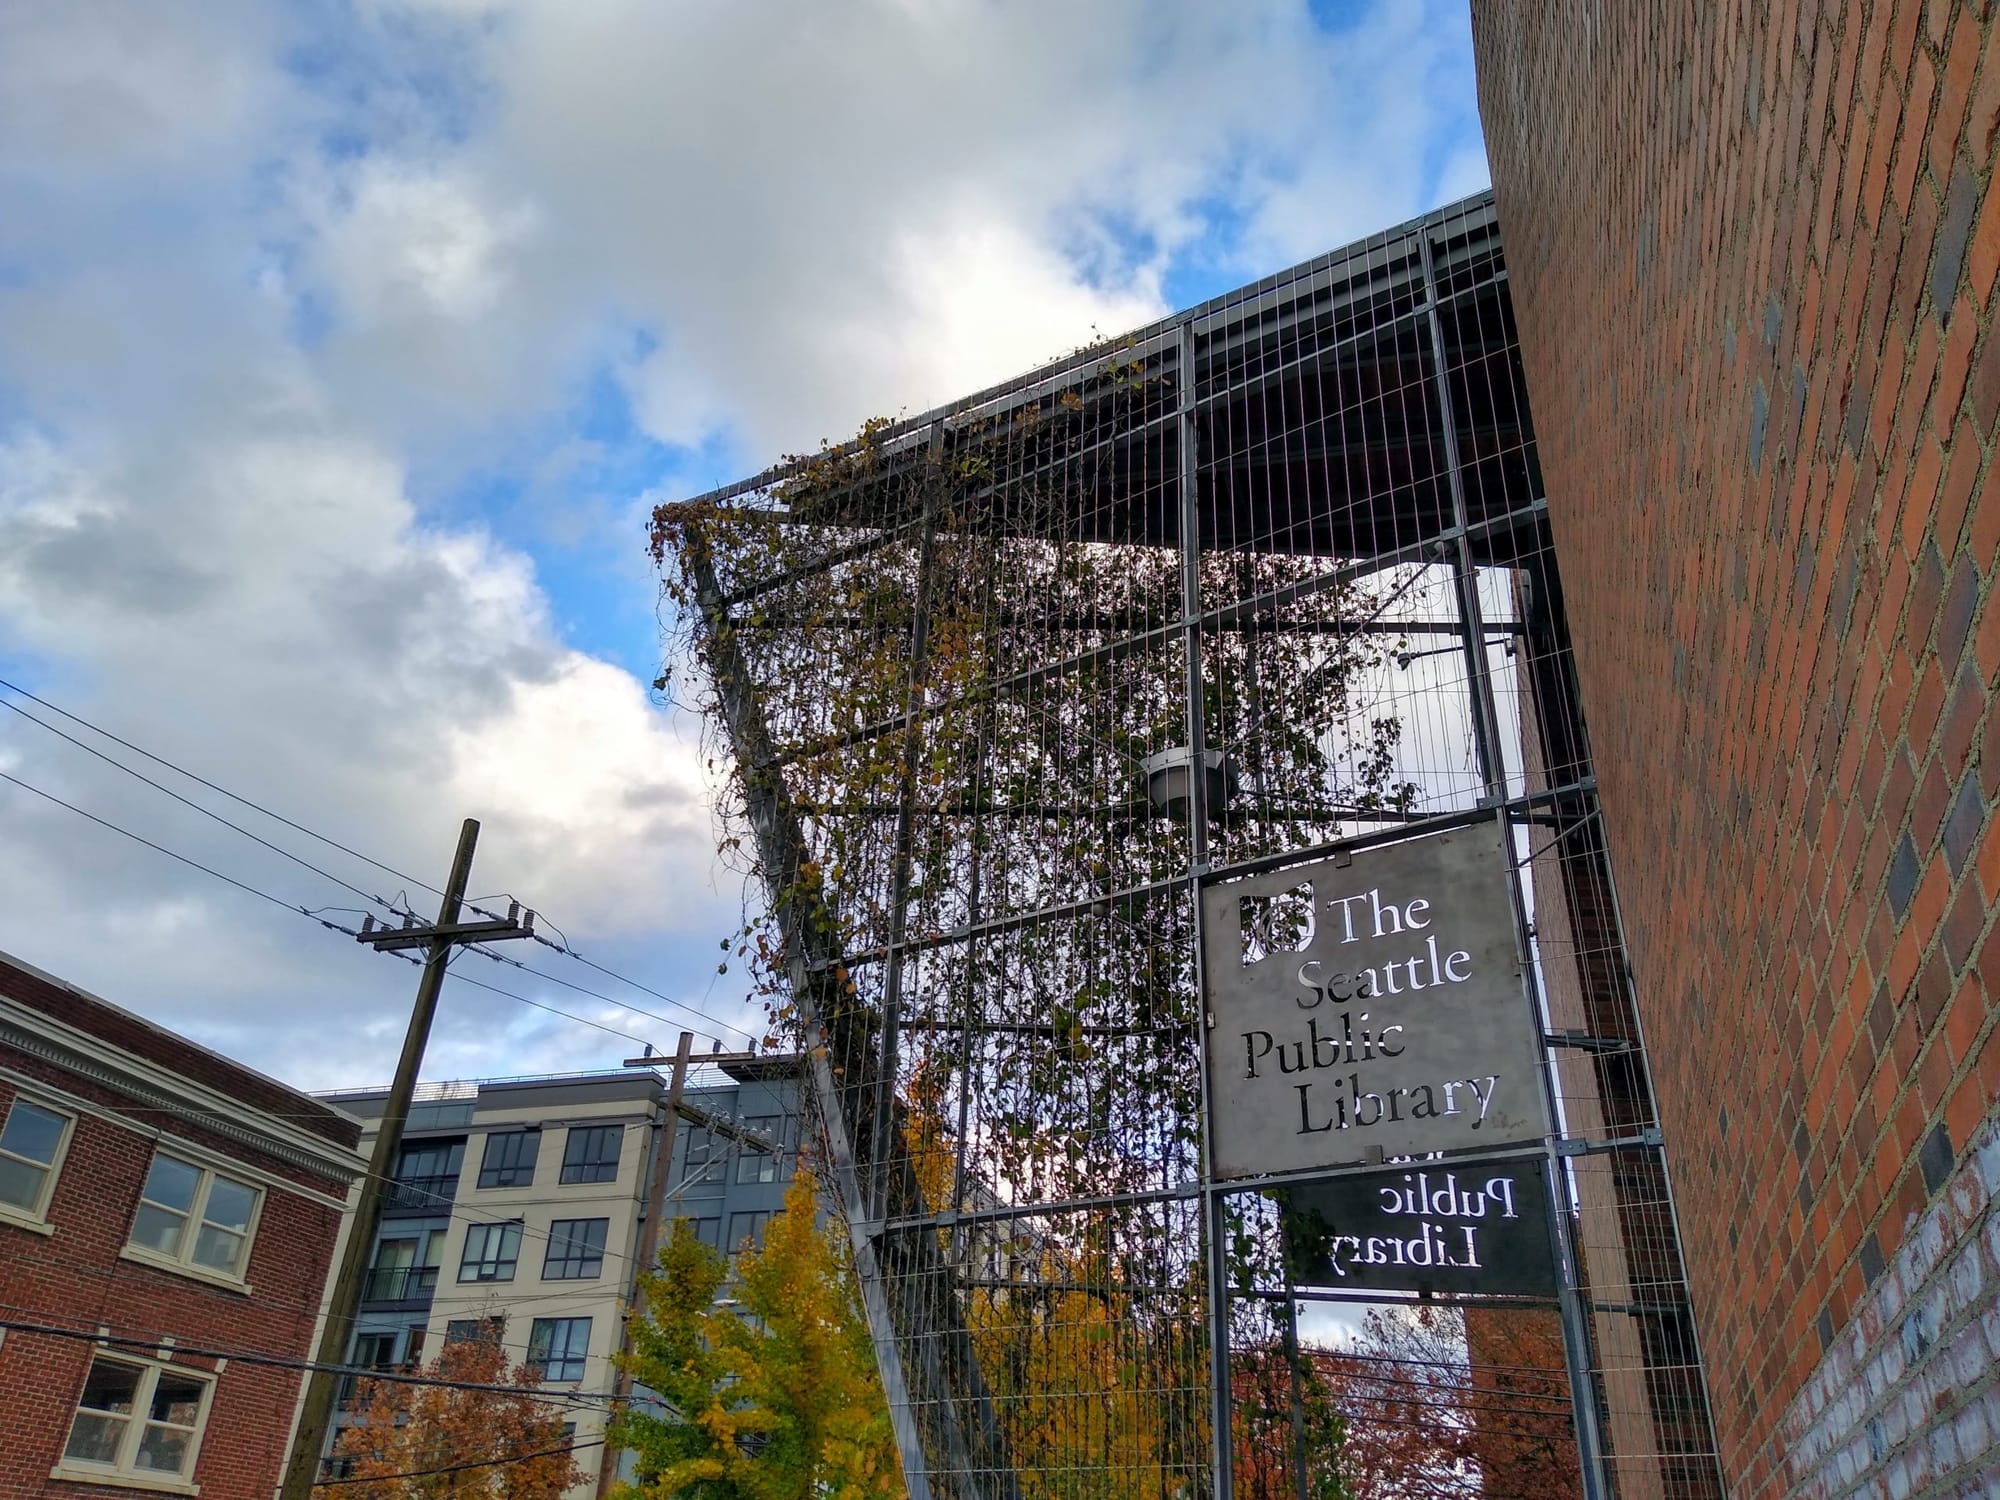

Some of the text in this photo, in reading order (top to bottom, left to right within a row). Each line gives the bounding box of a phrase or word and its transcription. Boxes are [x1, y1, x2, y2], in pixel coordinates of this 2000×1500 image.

[1327, 888, 1432, 944] The
[1296, 935, 1472, 1010] Seattle
[1241, 1012, 1406, 1079] Public
[1295, 1073, 1500, 1135] Library
